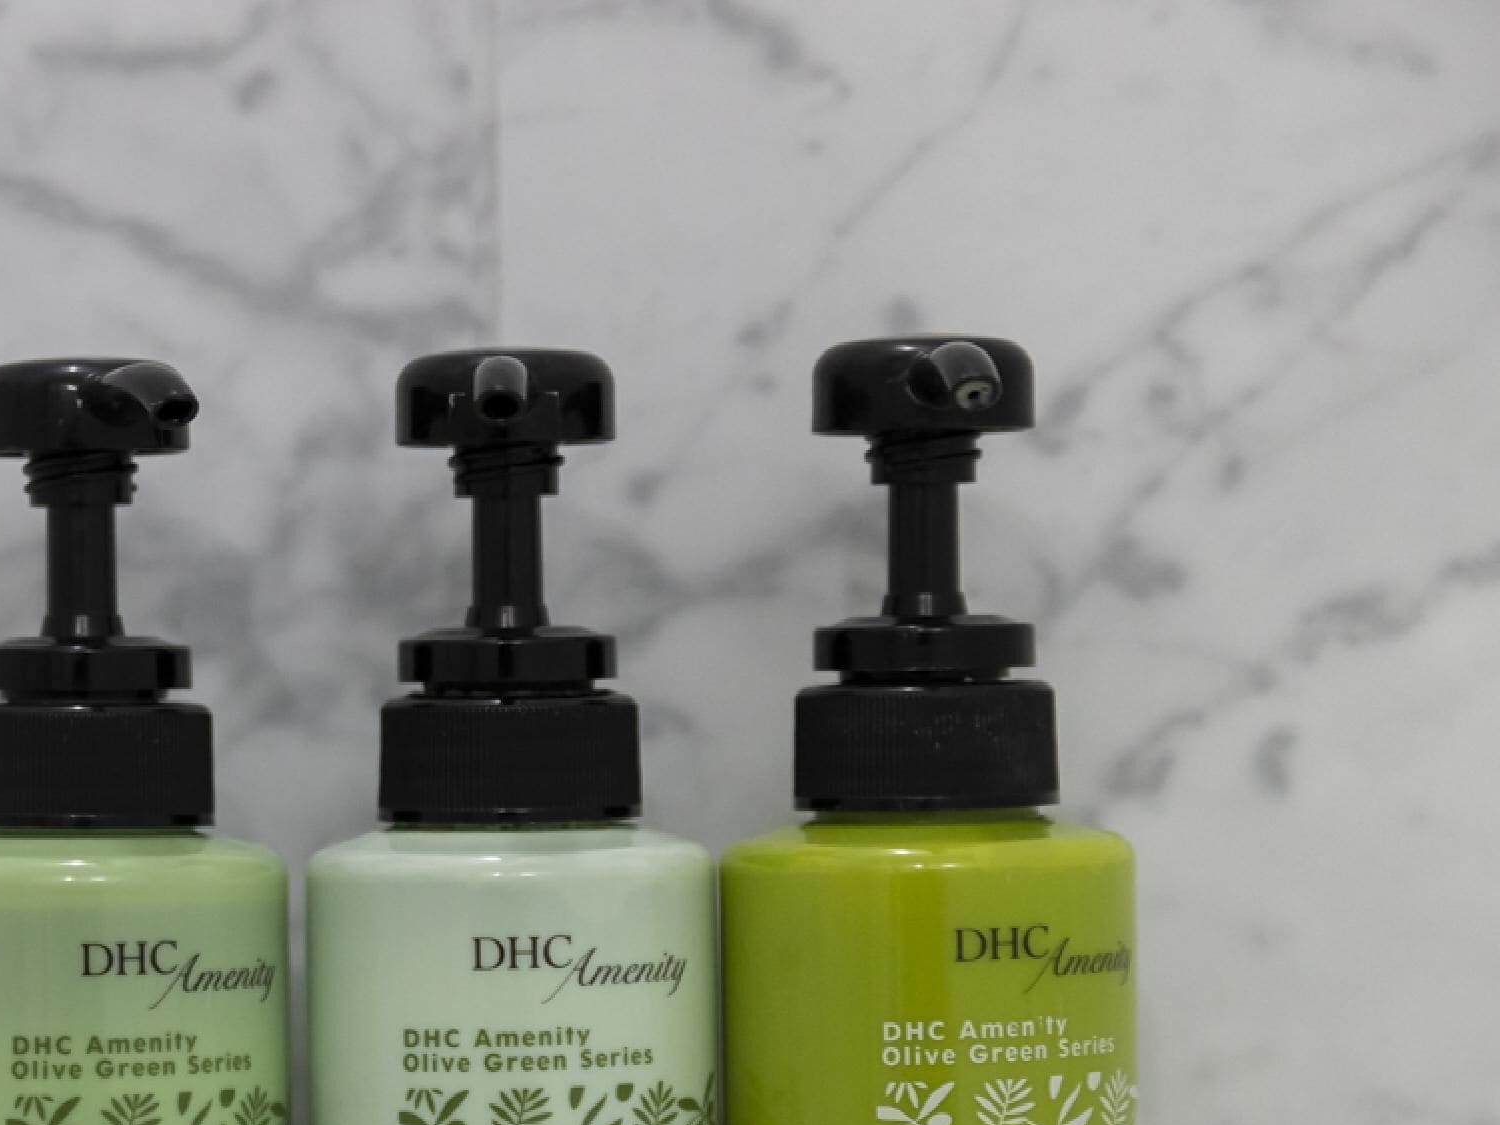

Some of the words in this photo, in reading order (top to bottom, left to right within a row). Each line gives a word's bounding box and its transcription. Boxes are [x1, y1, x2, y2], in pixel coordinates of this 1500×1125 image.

[472, 934, 574, 972] DHC
[540, 947, 688, 1005] Amenity
[955, 924, 1050, 963] DHC
[1022, 936, 1133, 996] Amenity
[80, 940, 179, 977] DHC
[148, 953, 276, 1009] Amenity
[402, 1028, 461, 1049] DHC
[473, 1025, 591, 1048] Amenity
[882, 1020, 946, 1042] DHC
[959, 1015, 1068, 1041] Amenty
[11, 1035, 73, 1056] DHC
[86, 1031, 199, 1055] Amenity
[881, 1045, 957, 1067] Olive
[969, 1043, 1048, 1065] Green
[1058, 1035, 1116, 1058] Series
[10, 1059, 83, 1080] Olive
[94, 1059, 176, 1080] Green
[187, 1053, 252, 1074] Series
[402, 1052, 471, 1073] Olive
[483, 1052, 568, 1073] Green
[579, 1046, 654, 1070] Series
